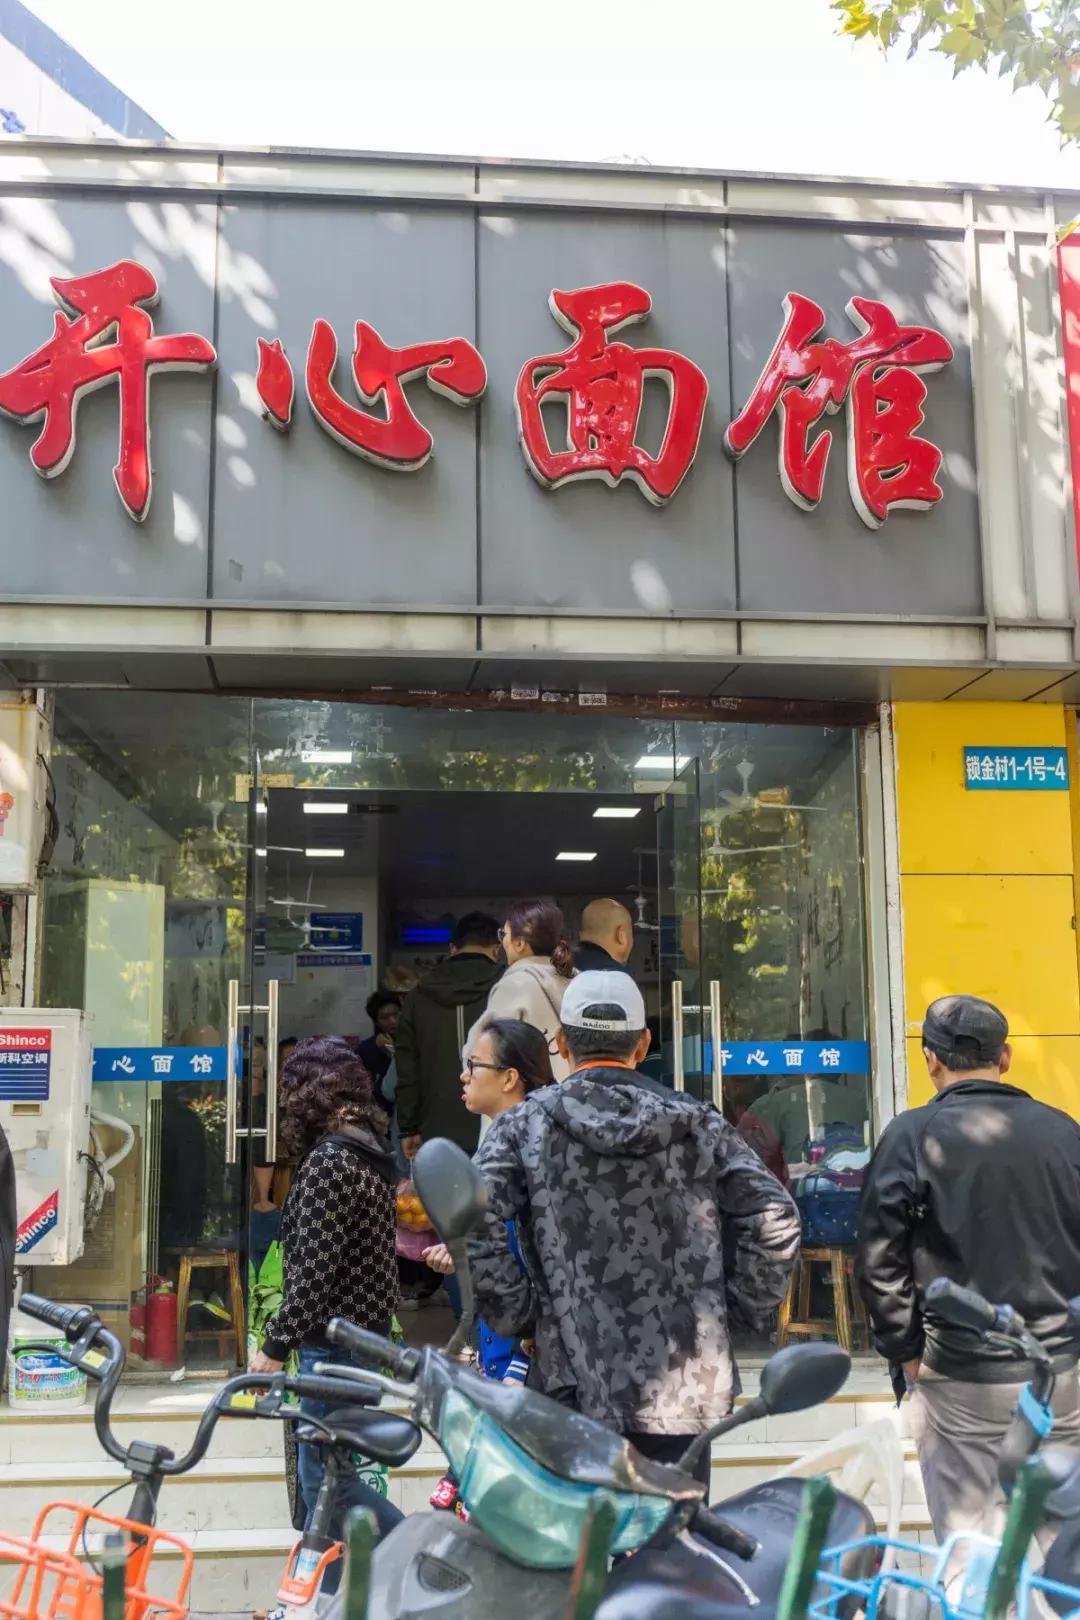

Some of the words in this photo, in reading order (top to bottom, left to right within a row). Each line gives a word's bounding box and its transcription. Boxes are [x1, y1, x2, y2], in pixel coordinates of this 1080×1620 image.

[0, 258, 955, 531] 开心面馆
[966, 755, 1066, 781] 锁金村1-1号-4
[0, 1035, 46, 1046] Shinco
[93, 1054, 213, 1074] 心面馆
